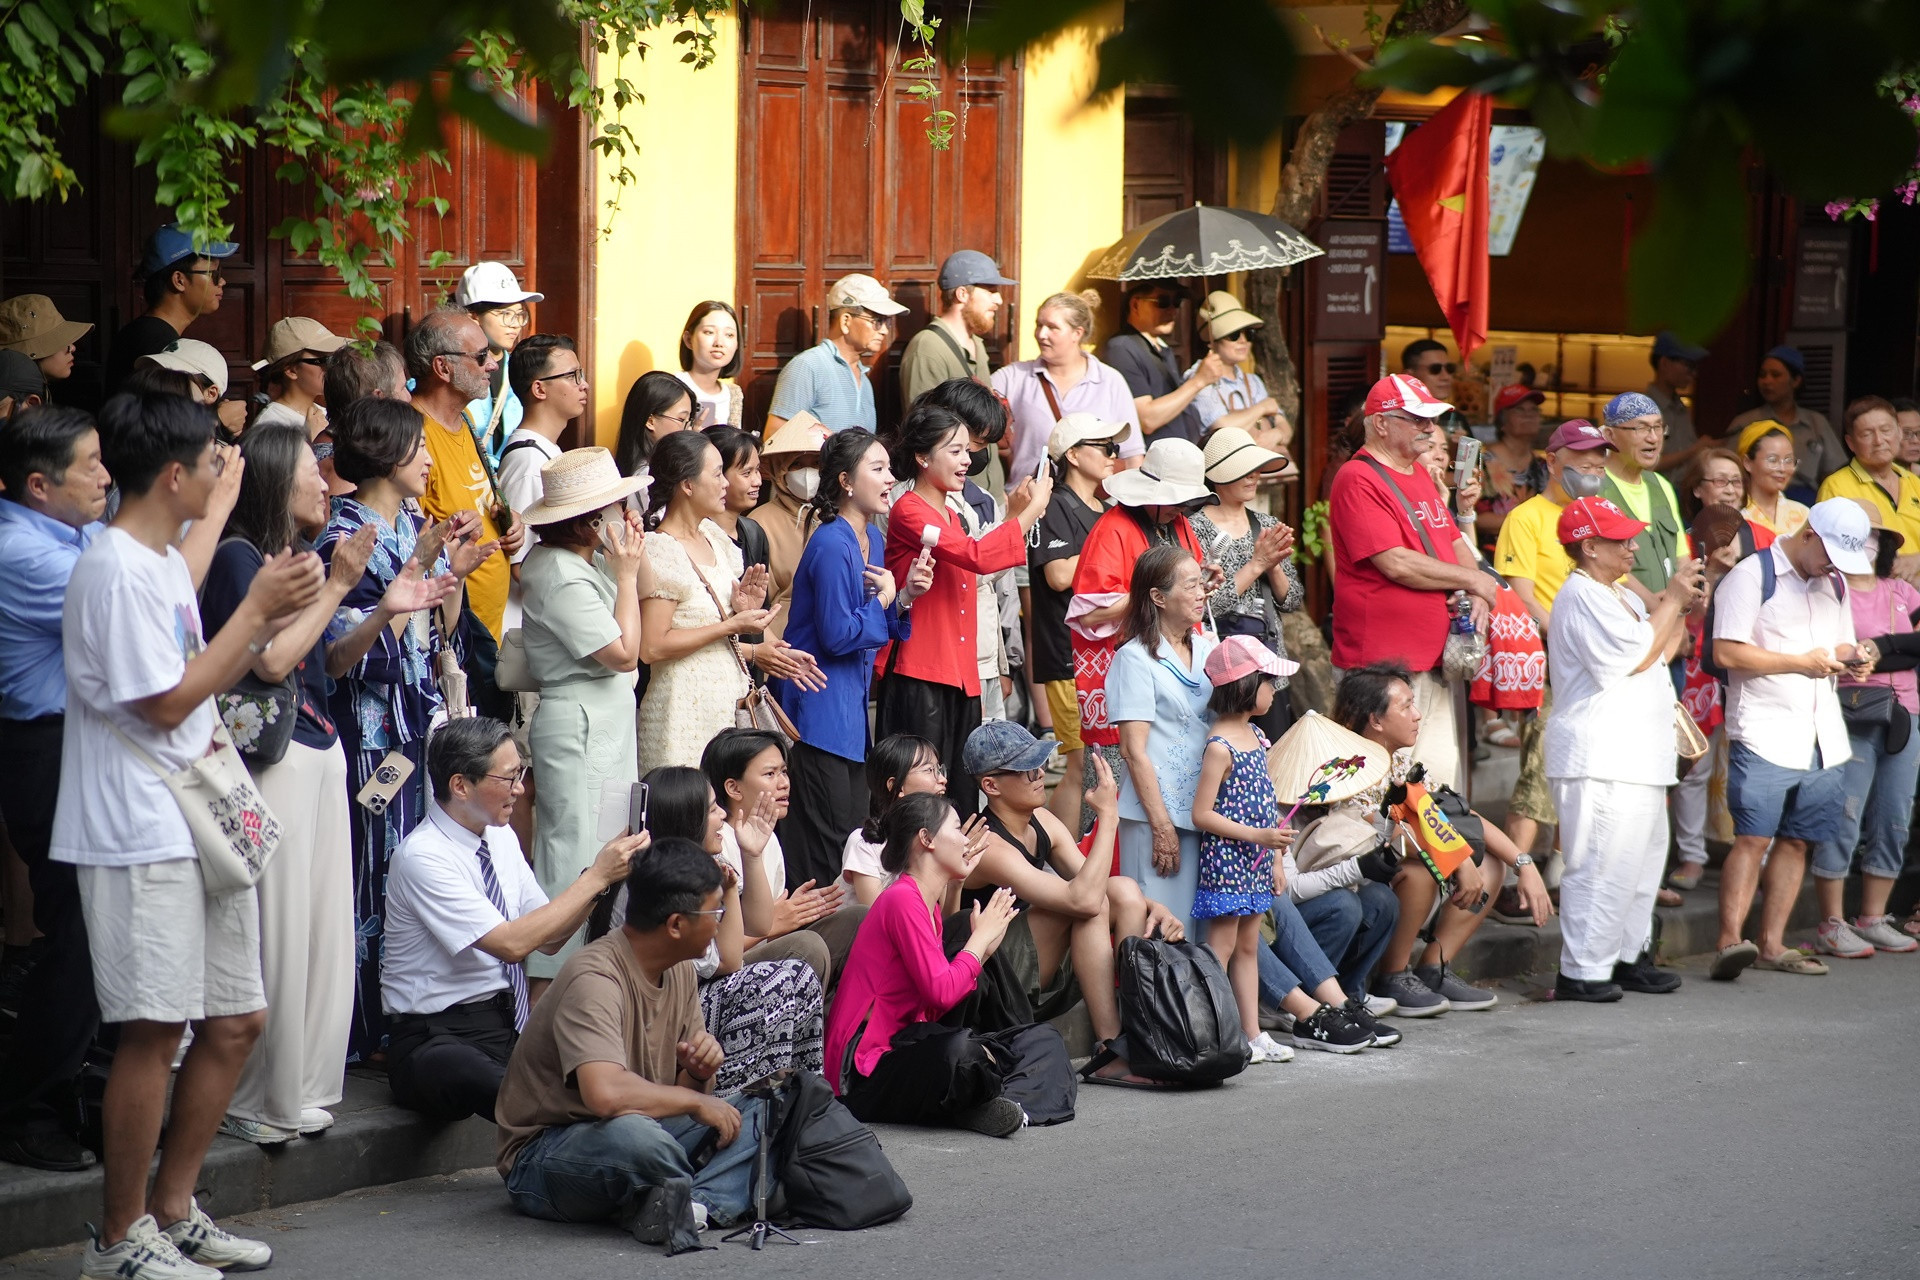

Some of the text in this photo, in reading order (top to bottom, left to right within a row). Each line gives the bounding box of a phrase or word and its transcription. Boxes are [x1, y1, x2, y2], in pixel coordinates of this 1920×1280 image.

[1382, 399, 1398, 409] QBE
[1572, 525, 1592, 538] QBE
[1423, 808, 1456, 844] tour
